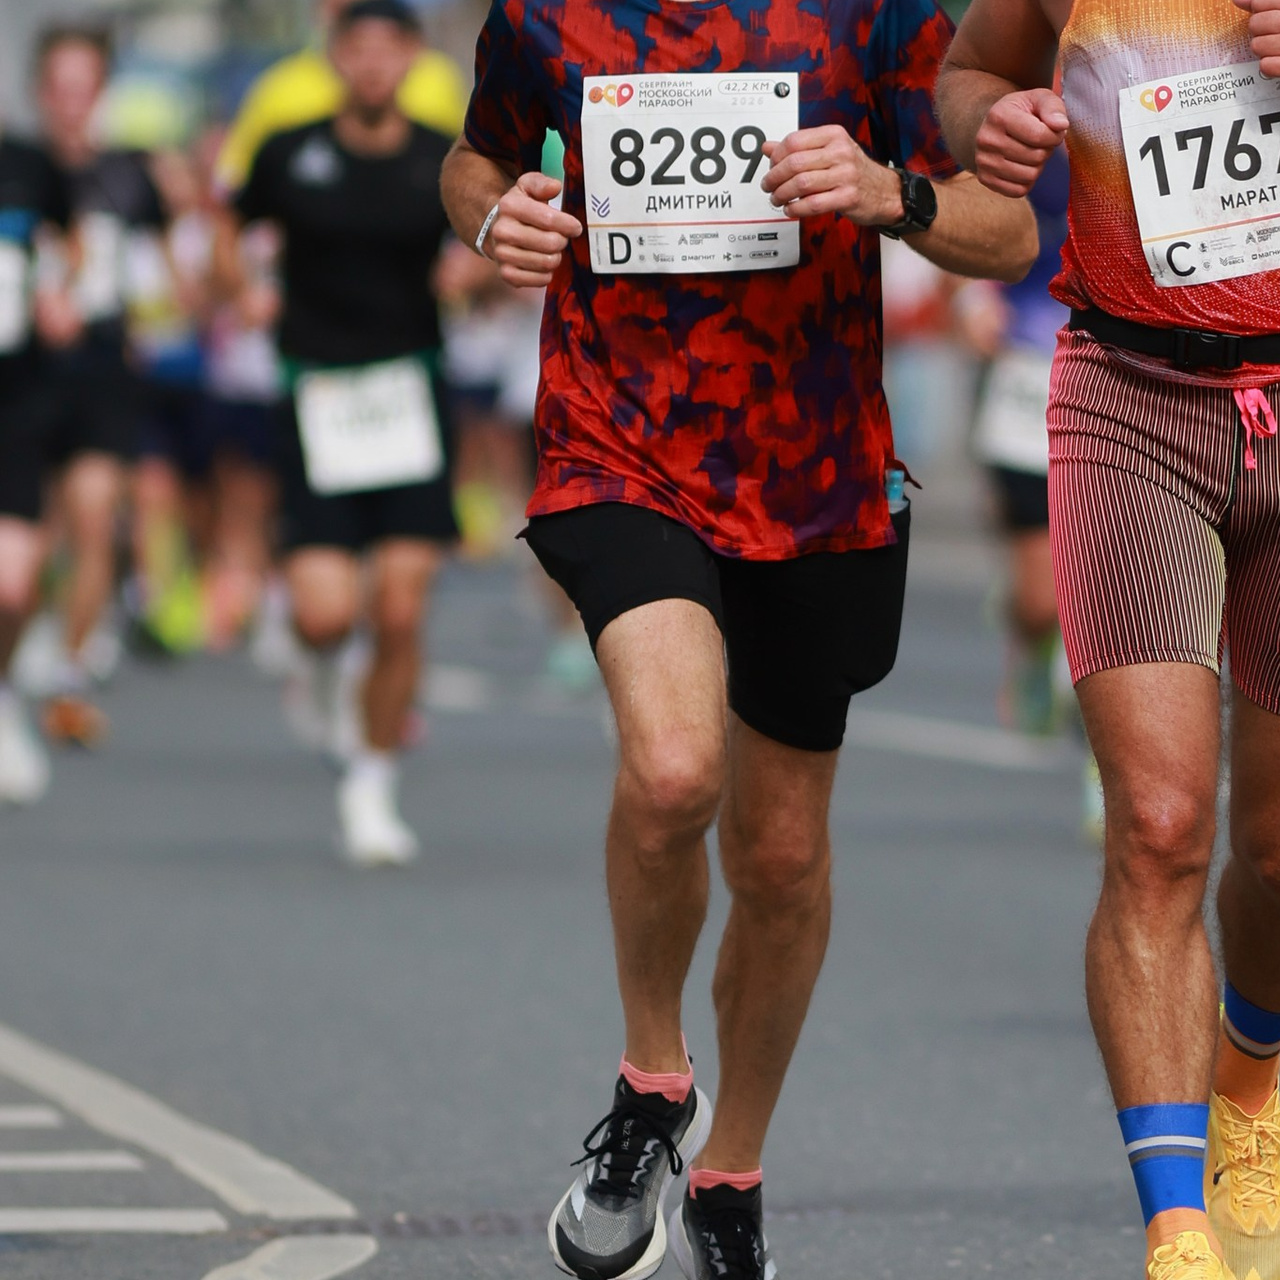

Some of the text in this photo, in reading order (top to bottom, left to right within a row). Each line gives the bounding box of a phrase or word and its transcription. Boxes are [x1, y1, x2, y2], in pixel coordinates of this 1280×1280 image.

[724, 82, 770, 92] 42,2 КМ
[1177, 72, 1233, 88] СБЕРПРАЙМ
[1178, 75, 1255, 98] МОСКОВСКИЙ
[638, 88, 712, 99] МОСКОВСКИЙ
[638, 98, 693, 108] МАРАФОН
[1180, 90, 1237, 108] МАРАФОН
[609, 125, 767, 187] 8289
[645, 191, 732, 213] ДМИТРИЙ
[1220, 185, 1278, 211] МАРАТ
[607, 232, 632, 265] D
[1165, 241, 1196, 277] C
